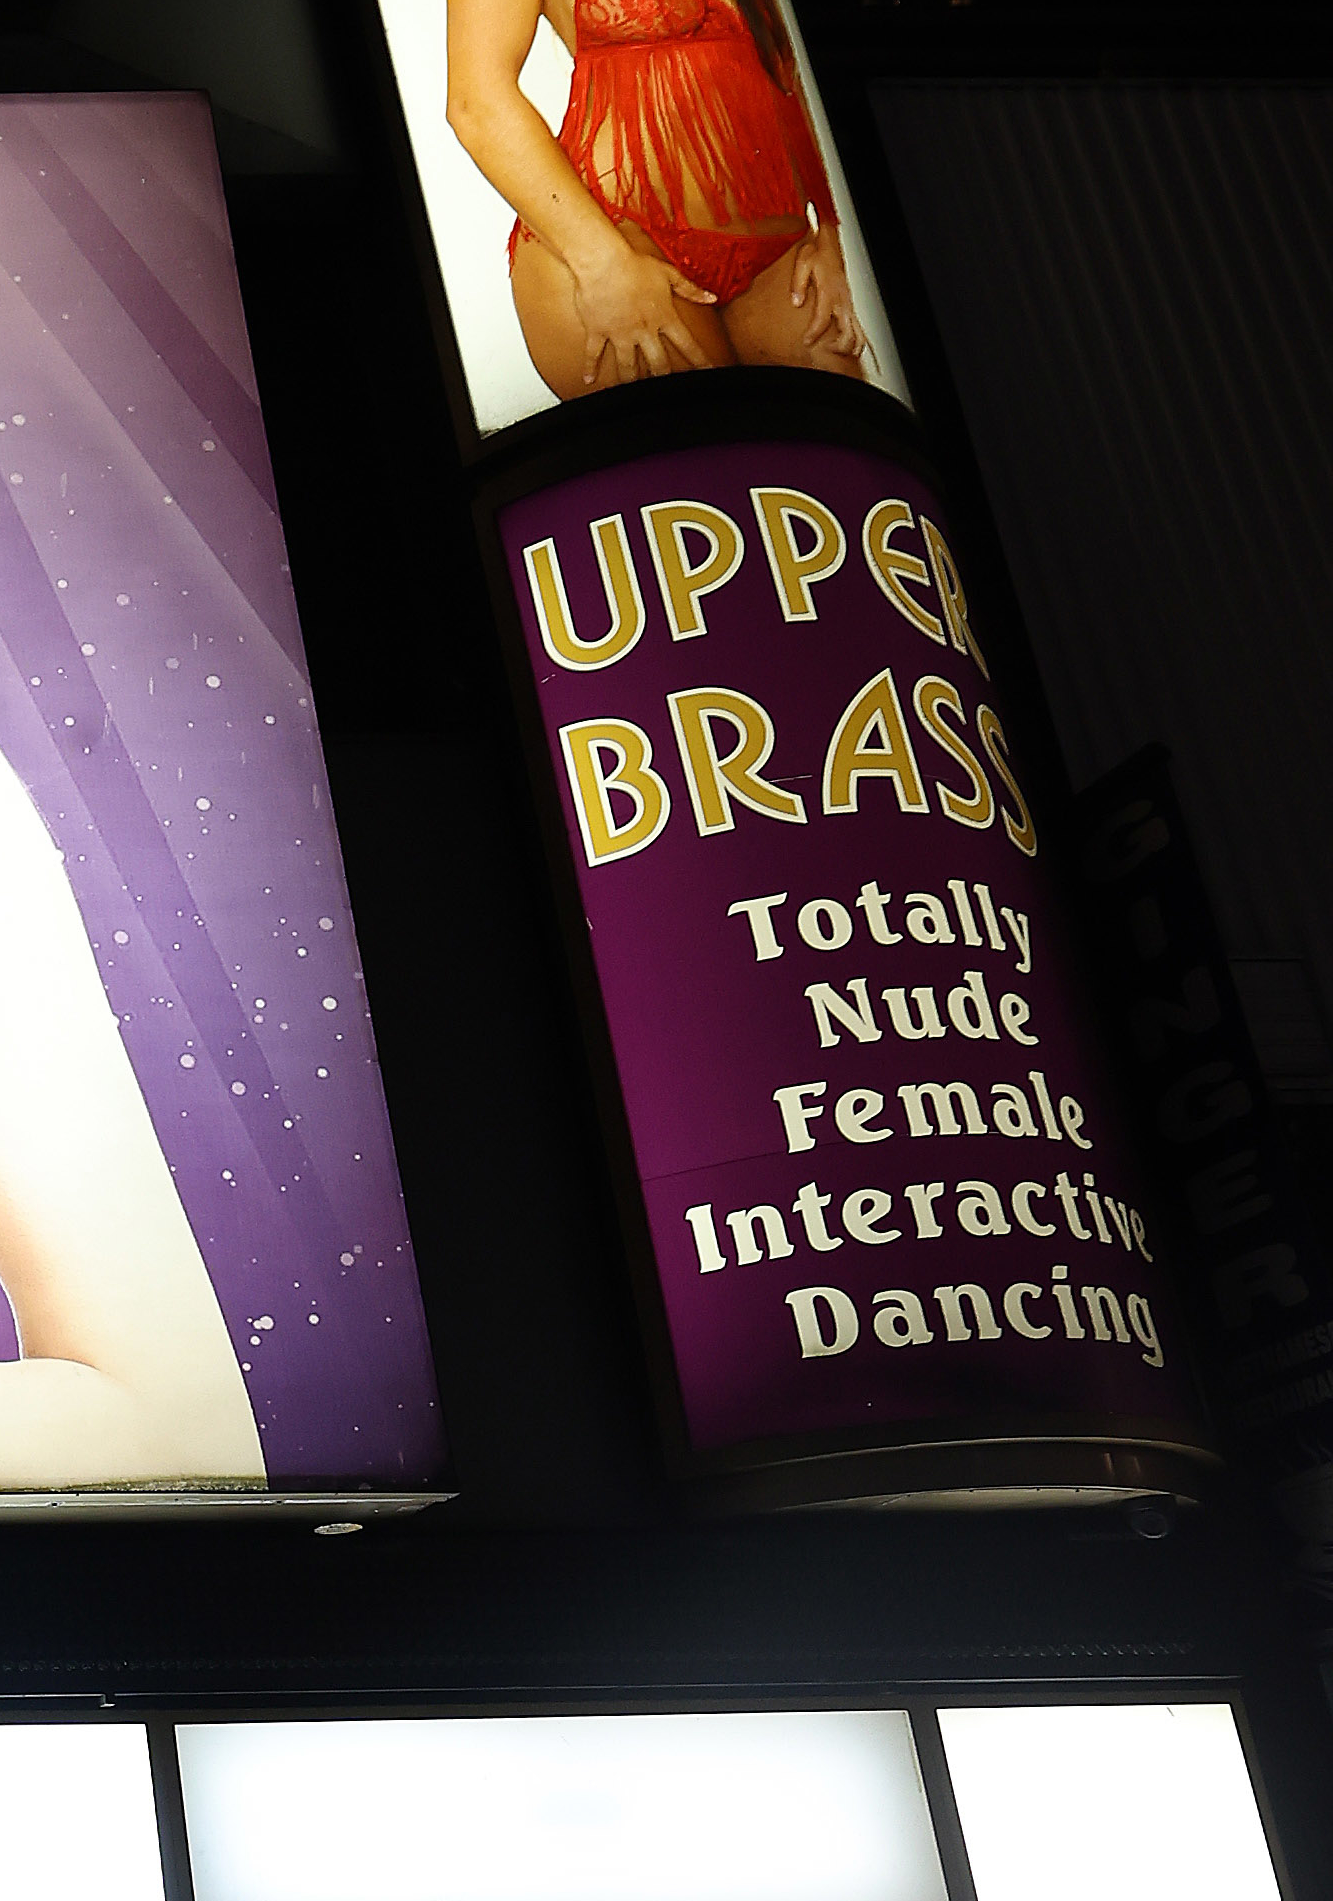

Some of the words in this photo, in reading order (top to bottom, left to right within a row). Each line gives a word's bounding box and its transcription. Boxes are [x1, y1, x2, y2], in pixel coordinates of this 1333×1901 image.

[522, 485, 990, 681] UPPER
[557, 667, 1040, 868] BRASS
[729, 879, 1032, 972] Totally
[804, 972, 1040, 1049] Nude
[773, 1070, 1093, 1155] Female
[685, 1173, 1156, 1274] Interactive
[784, 1265, 1166, 1369] Dancing
